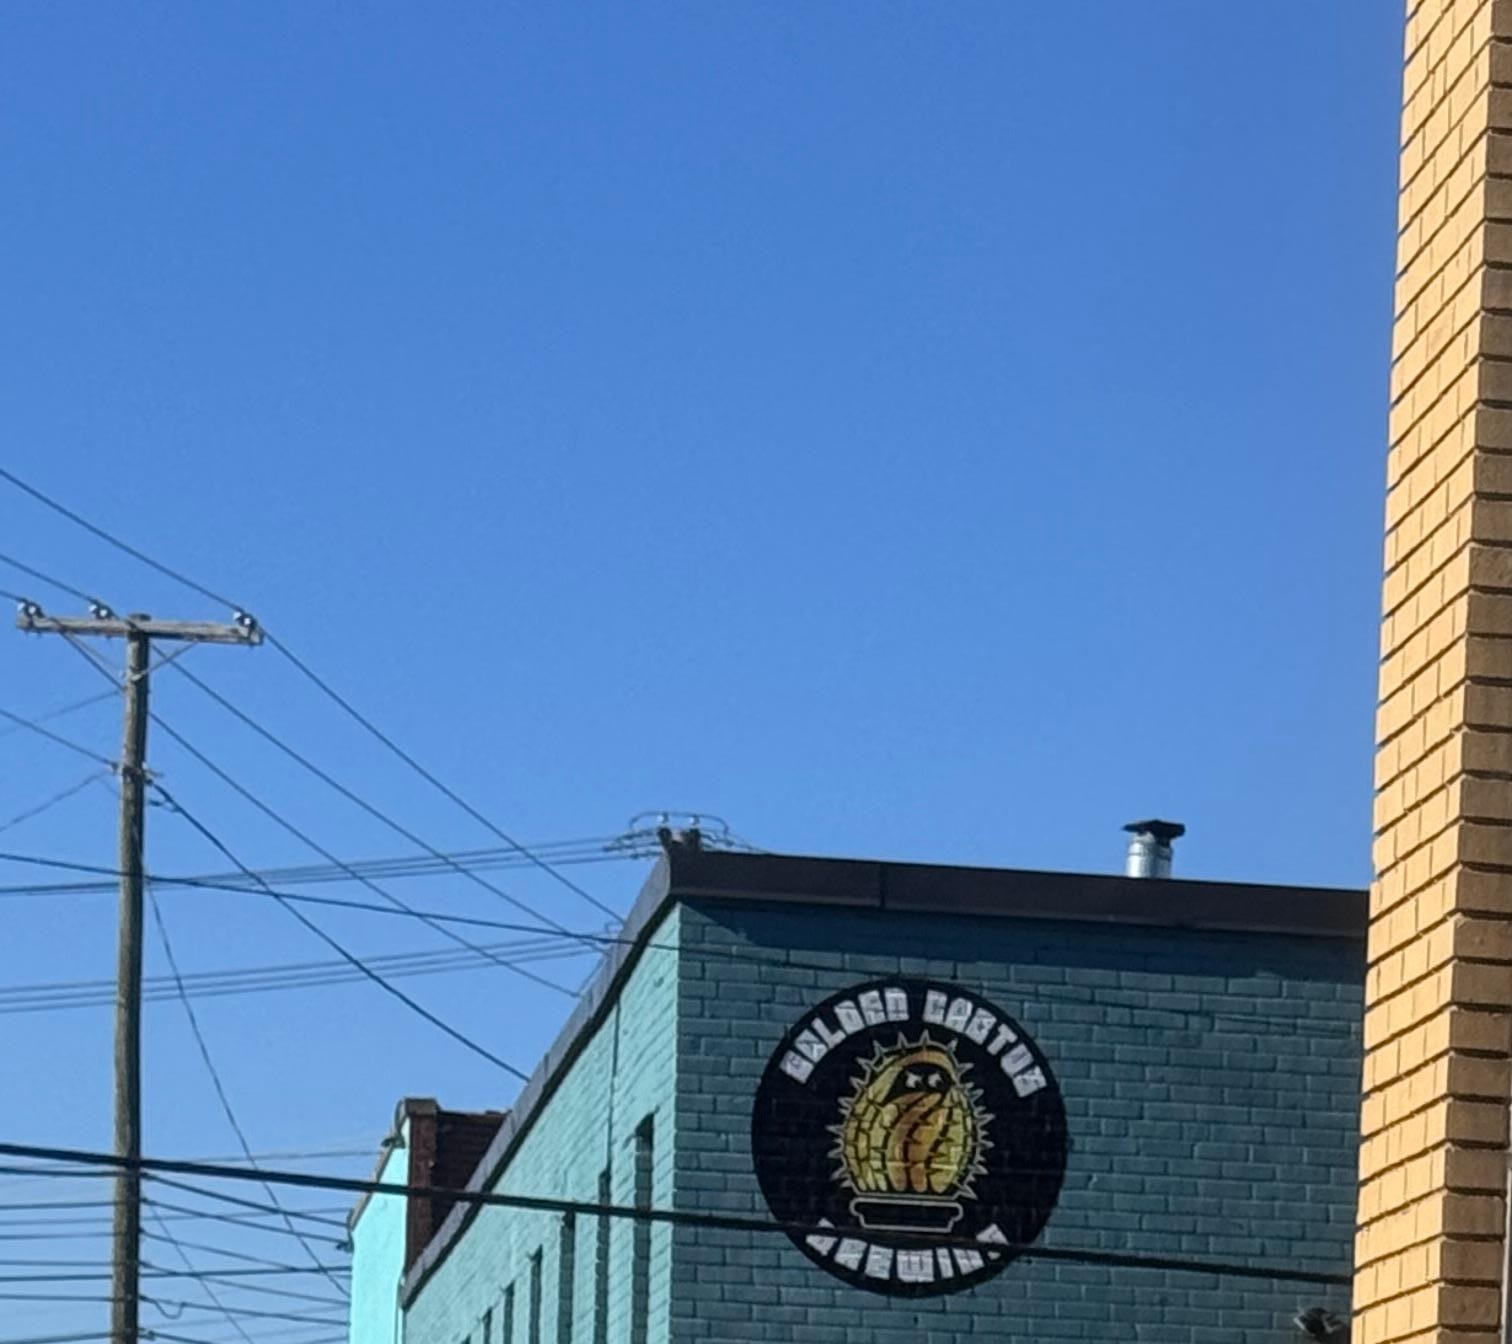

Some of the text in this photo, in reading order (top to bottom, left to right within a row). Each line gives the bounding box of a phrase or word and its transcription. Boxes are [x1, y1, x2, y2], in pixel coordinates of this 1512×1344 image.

[779, 987, 1048, 1098] GOLDEN CACTUS
[805, 1217, 1010, 1283] BREWING
